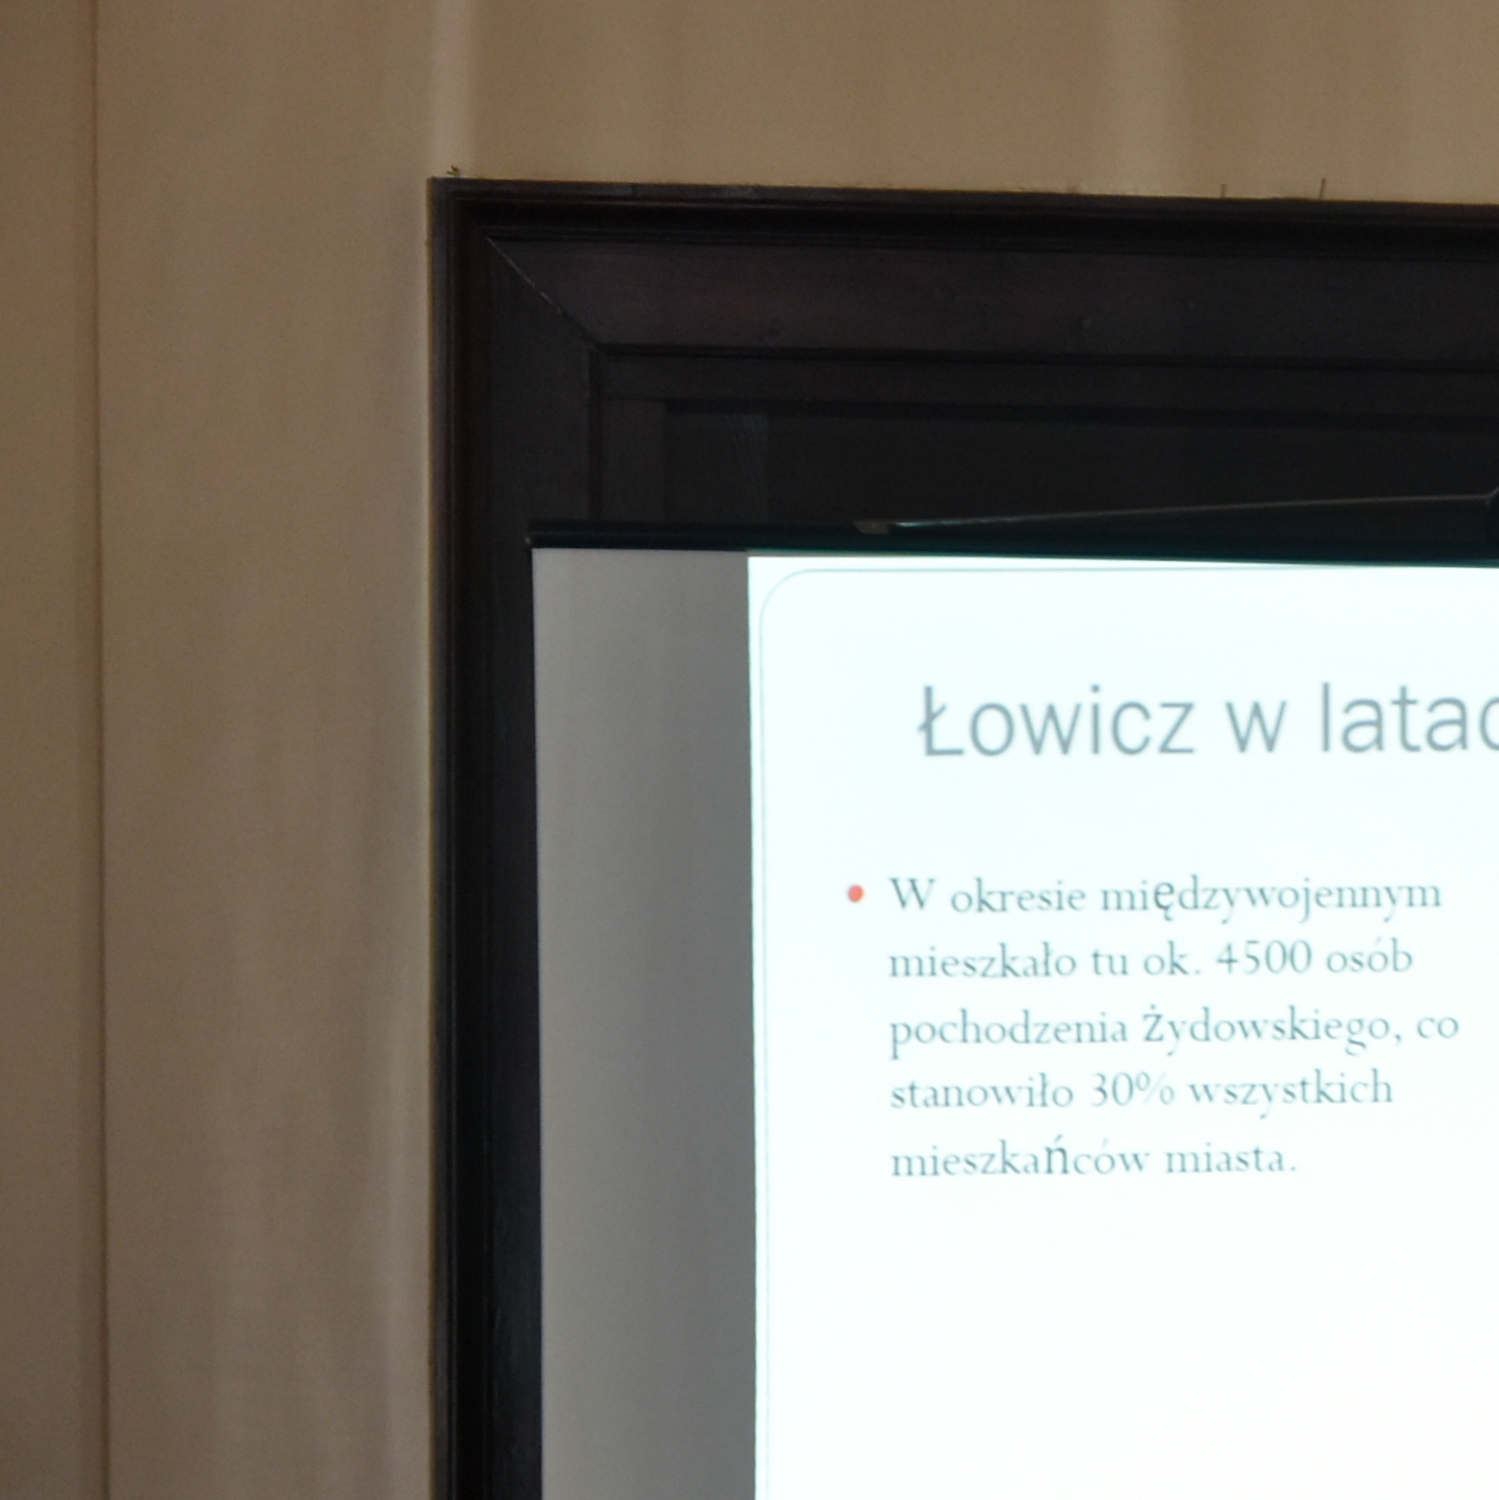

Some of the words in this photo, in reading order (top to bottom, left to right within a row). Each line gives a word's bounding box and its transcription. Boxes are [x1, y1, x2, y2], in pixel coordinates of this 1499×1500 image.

[917, 684, 1196, 758] Łowicz
[1225, 700, 1288, 755] w
[887, 876, 937, 911] W
[950, 876, 1088, 914] okresie
[1099, 873, 1443, 925] międzywojennym
[888, 940, 1078, 979] mieszkało
[1091, 949, 1130, 976] tu
[1143, 939, 1202, 976] ok.
[1215, 939, 1313, 975] 4500
[1325, 936, 1415, 974] osób
[890, 1007, 1129, 1061] pochodzenia
[1142, 1003, 1403, 1057] Żydowskiego,
[1416, 1016, 1460, 1040] co
[891, 1071, 1075, 1110] stanowiło
[1091, 1071, 1176, 1107] 30%
[1188, 1067, 1394, 1119] wszystkich
[891, 1133, 1151, 1178] mieszkańców
[1165, 1142, 1298, 1175] miasta.
